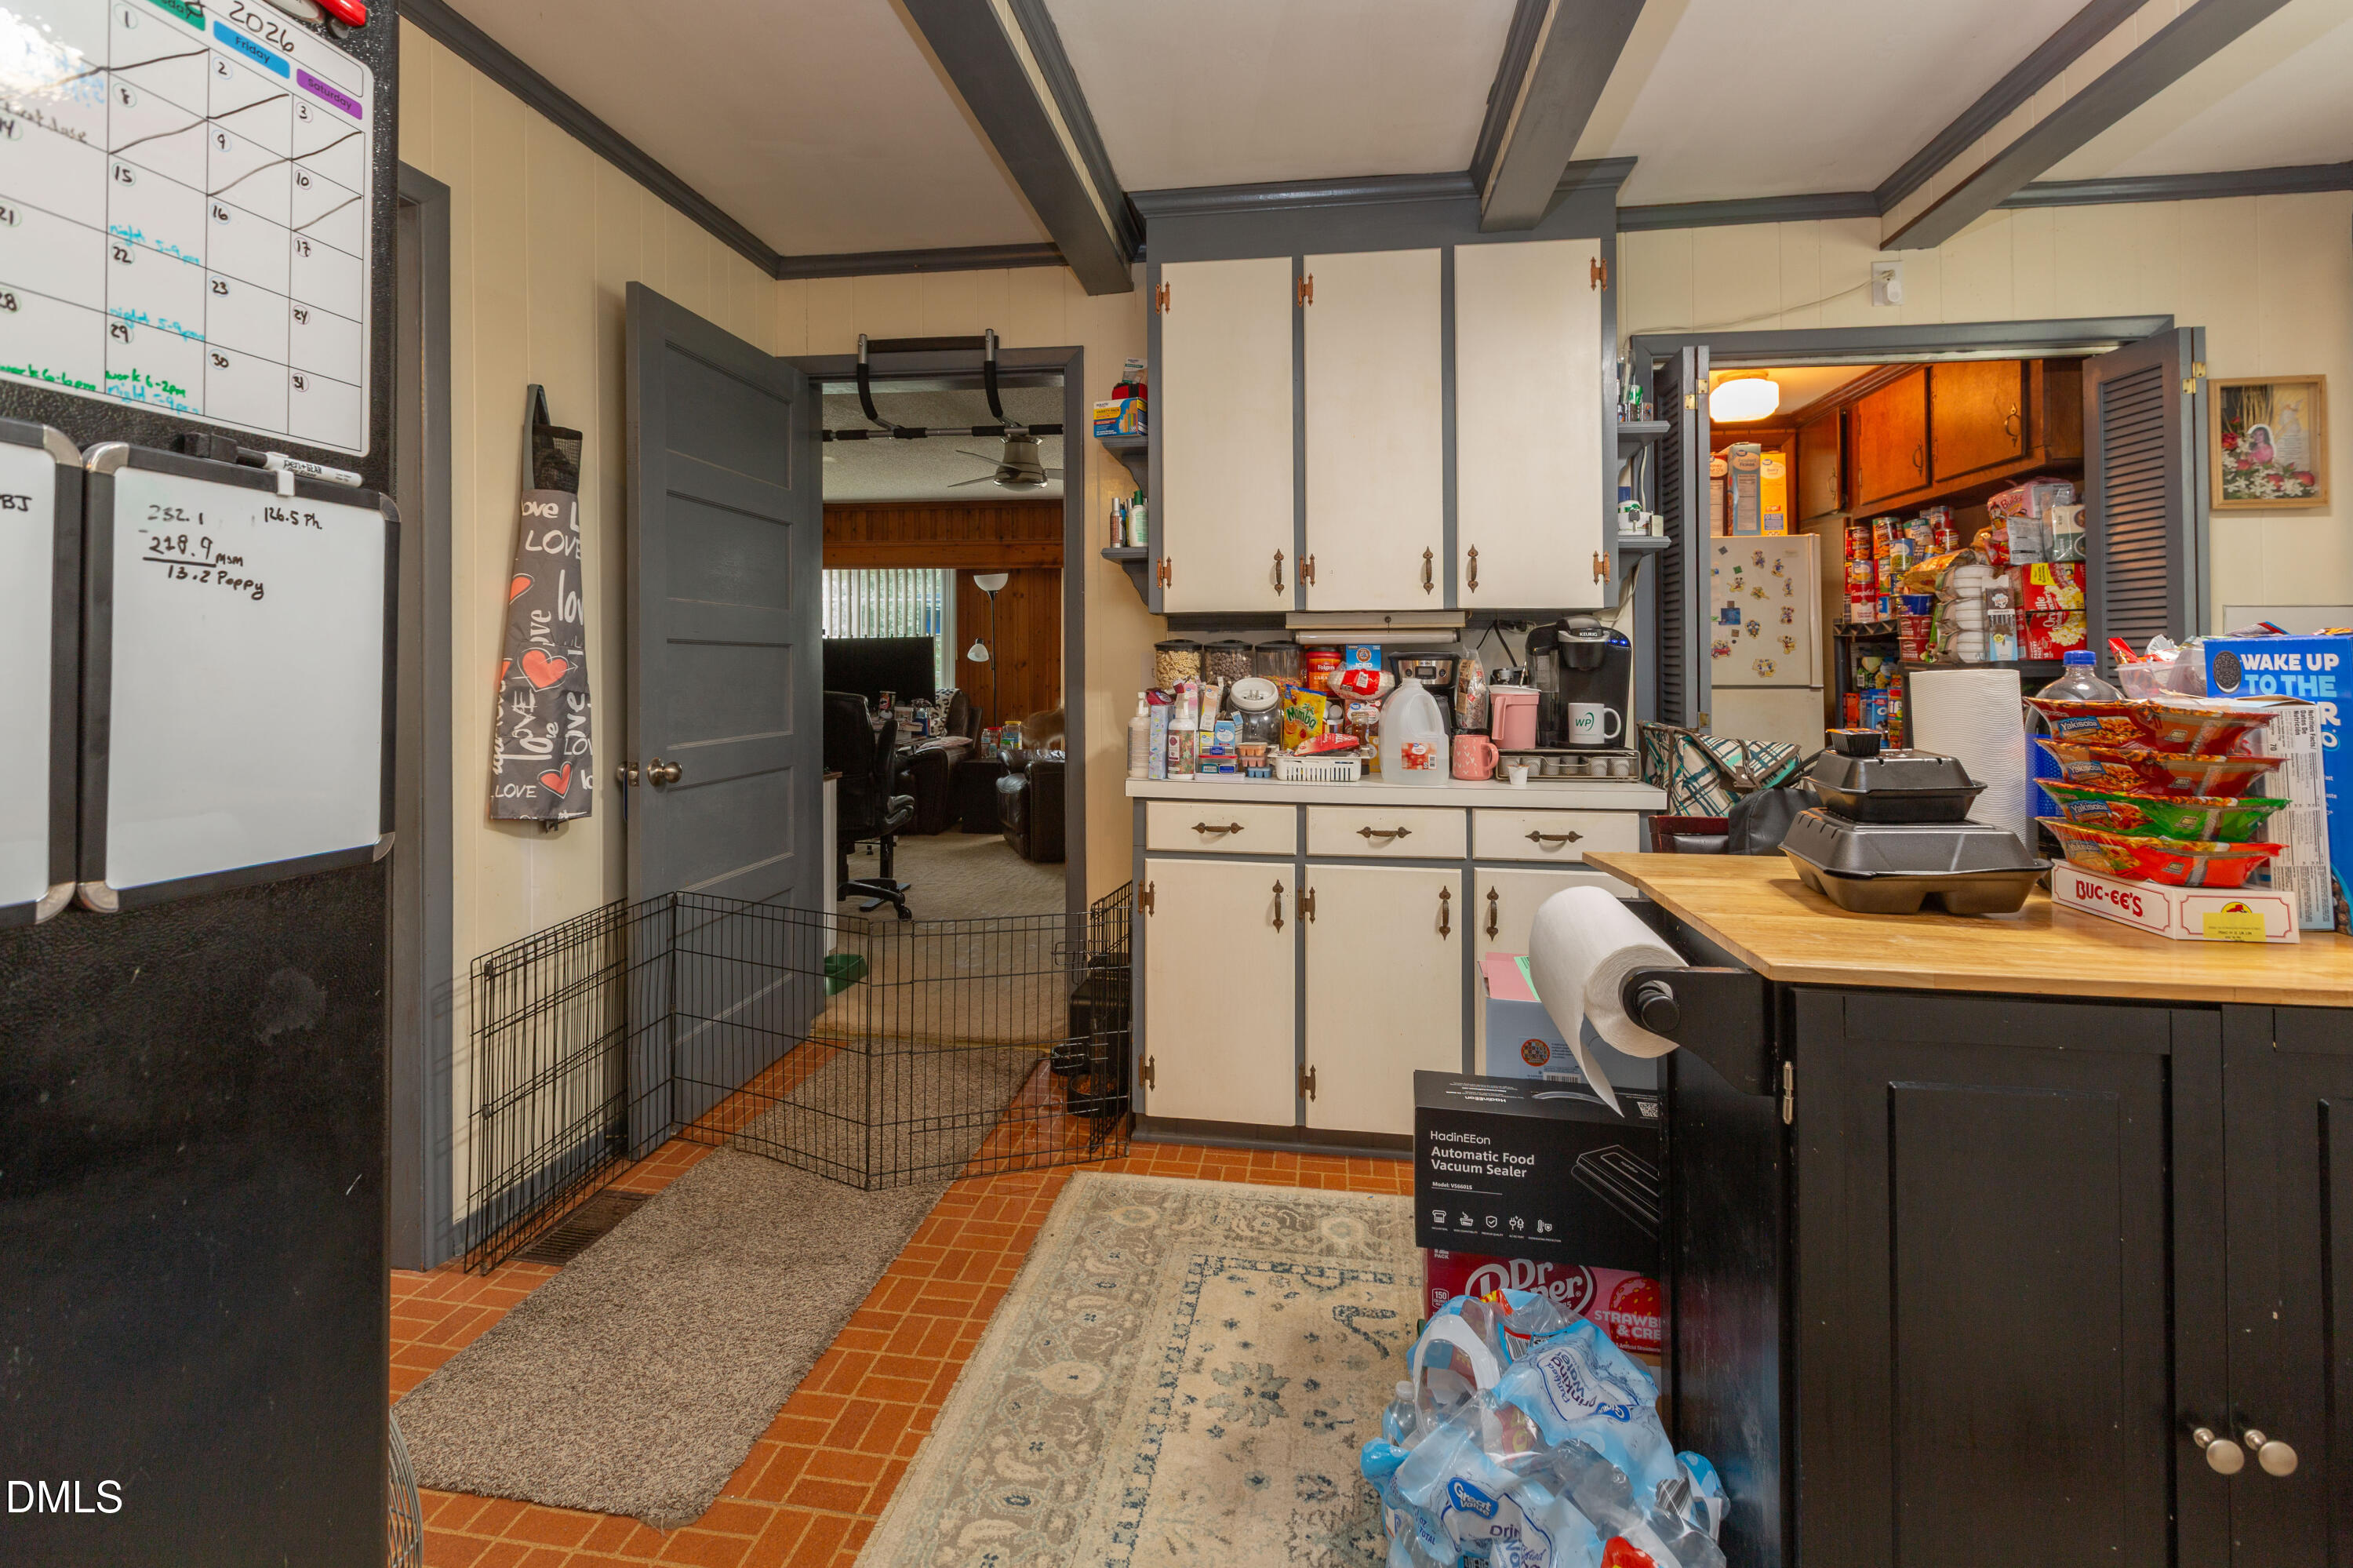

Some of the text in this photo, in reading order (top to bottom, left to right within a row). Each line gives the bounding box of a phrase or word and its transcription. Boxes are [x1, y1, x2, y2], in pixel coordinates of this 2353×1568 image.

[229, 1, 294, 53] 2026
[235, 37, 271, 64] Friday
[218, 61, 227, 75] 2
[307, 78, 352, 110] Saturday
[299, 106, 307, 119] 3
[217, 133, 225, 149] 9
[115, 166, 133, 183] 15
[297, 172, 309, 187] 10
[213, 206, 228, 220] 16
[113, 246, 132, 264] 22
[297, 240, 311, 257] 17
[212, 280, 228, 295] 23
[293, 309, 307, 325] 24
[111, 323, 129, 344] 29
[212, 353, 229, 368] 30
[105, 368, 141, 383] work
[293, 376, 304, 391] 31
[522, 500, 558, 518] ove
[2001, 496, 2023, 509] Bulda
[168, 565, 264, 600] 13.2 Poppy
[2240, 653, 2339, 671] WAKE UP
[2245, 674, 2337, 697] TO THE
[1286, 706, 1318, 730] Mamba
[2060, 719, 2097, 730] Yakisoba
[2069, 763, 2103, 773] Yakisoba
[495, 783, 536, 799] LOVE
[2071, 802, 2108, 813] Yakisoba
[2075, 879, 2144, 917] BUC-EE'S
[1431, 1130, 1490, 1144] HadinEEon
[1431, 1146, 1535, 1165] Automatic Food
[1431, 1159, 1527, 1177] Vacuum Sealer
[1509, 1258, 1554, 1289] Dr
[1435, 1290, 1447, 1300] 150
[1595, 1309, 1660, 1328] STRAWB
[1617, 1324, 1660, 1340] & CRE
[1555, 1351, 1584, 1398] Water
[1453, 1482, 1491, 1511] Great
[1460, 1499, 1490, 1517] Value
[1420, 1528, 1435, 1545] TOTAL
